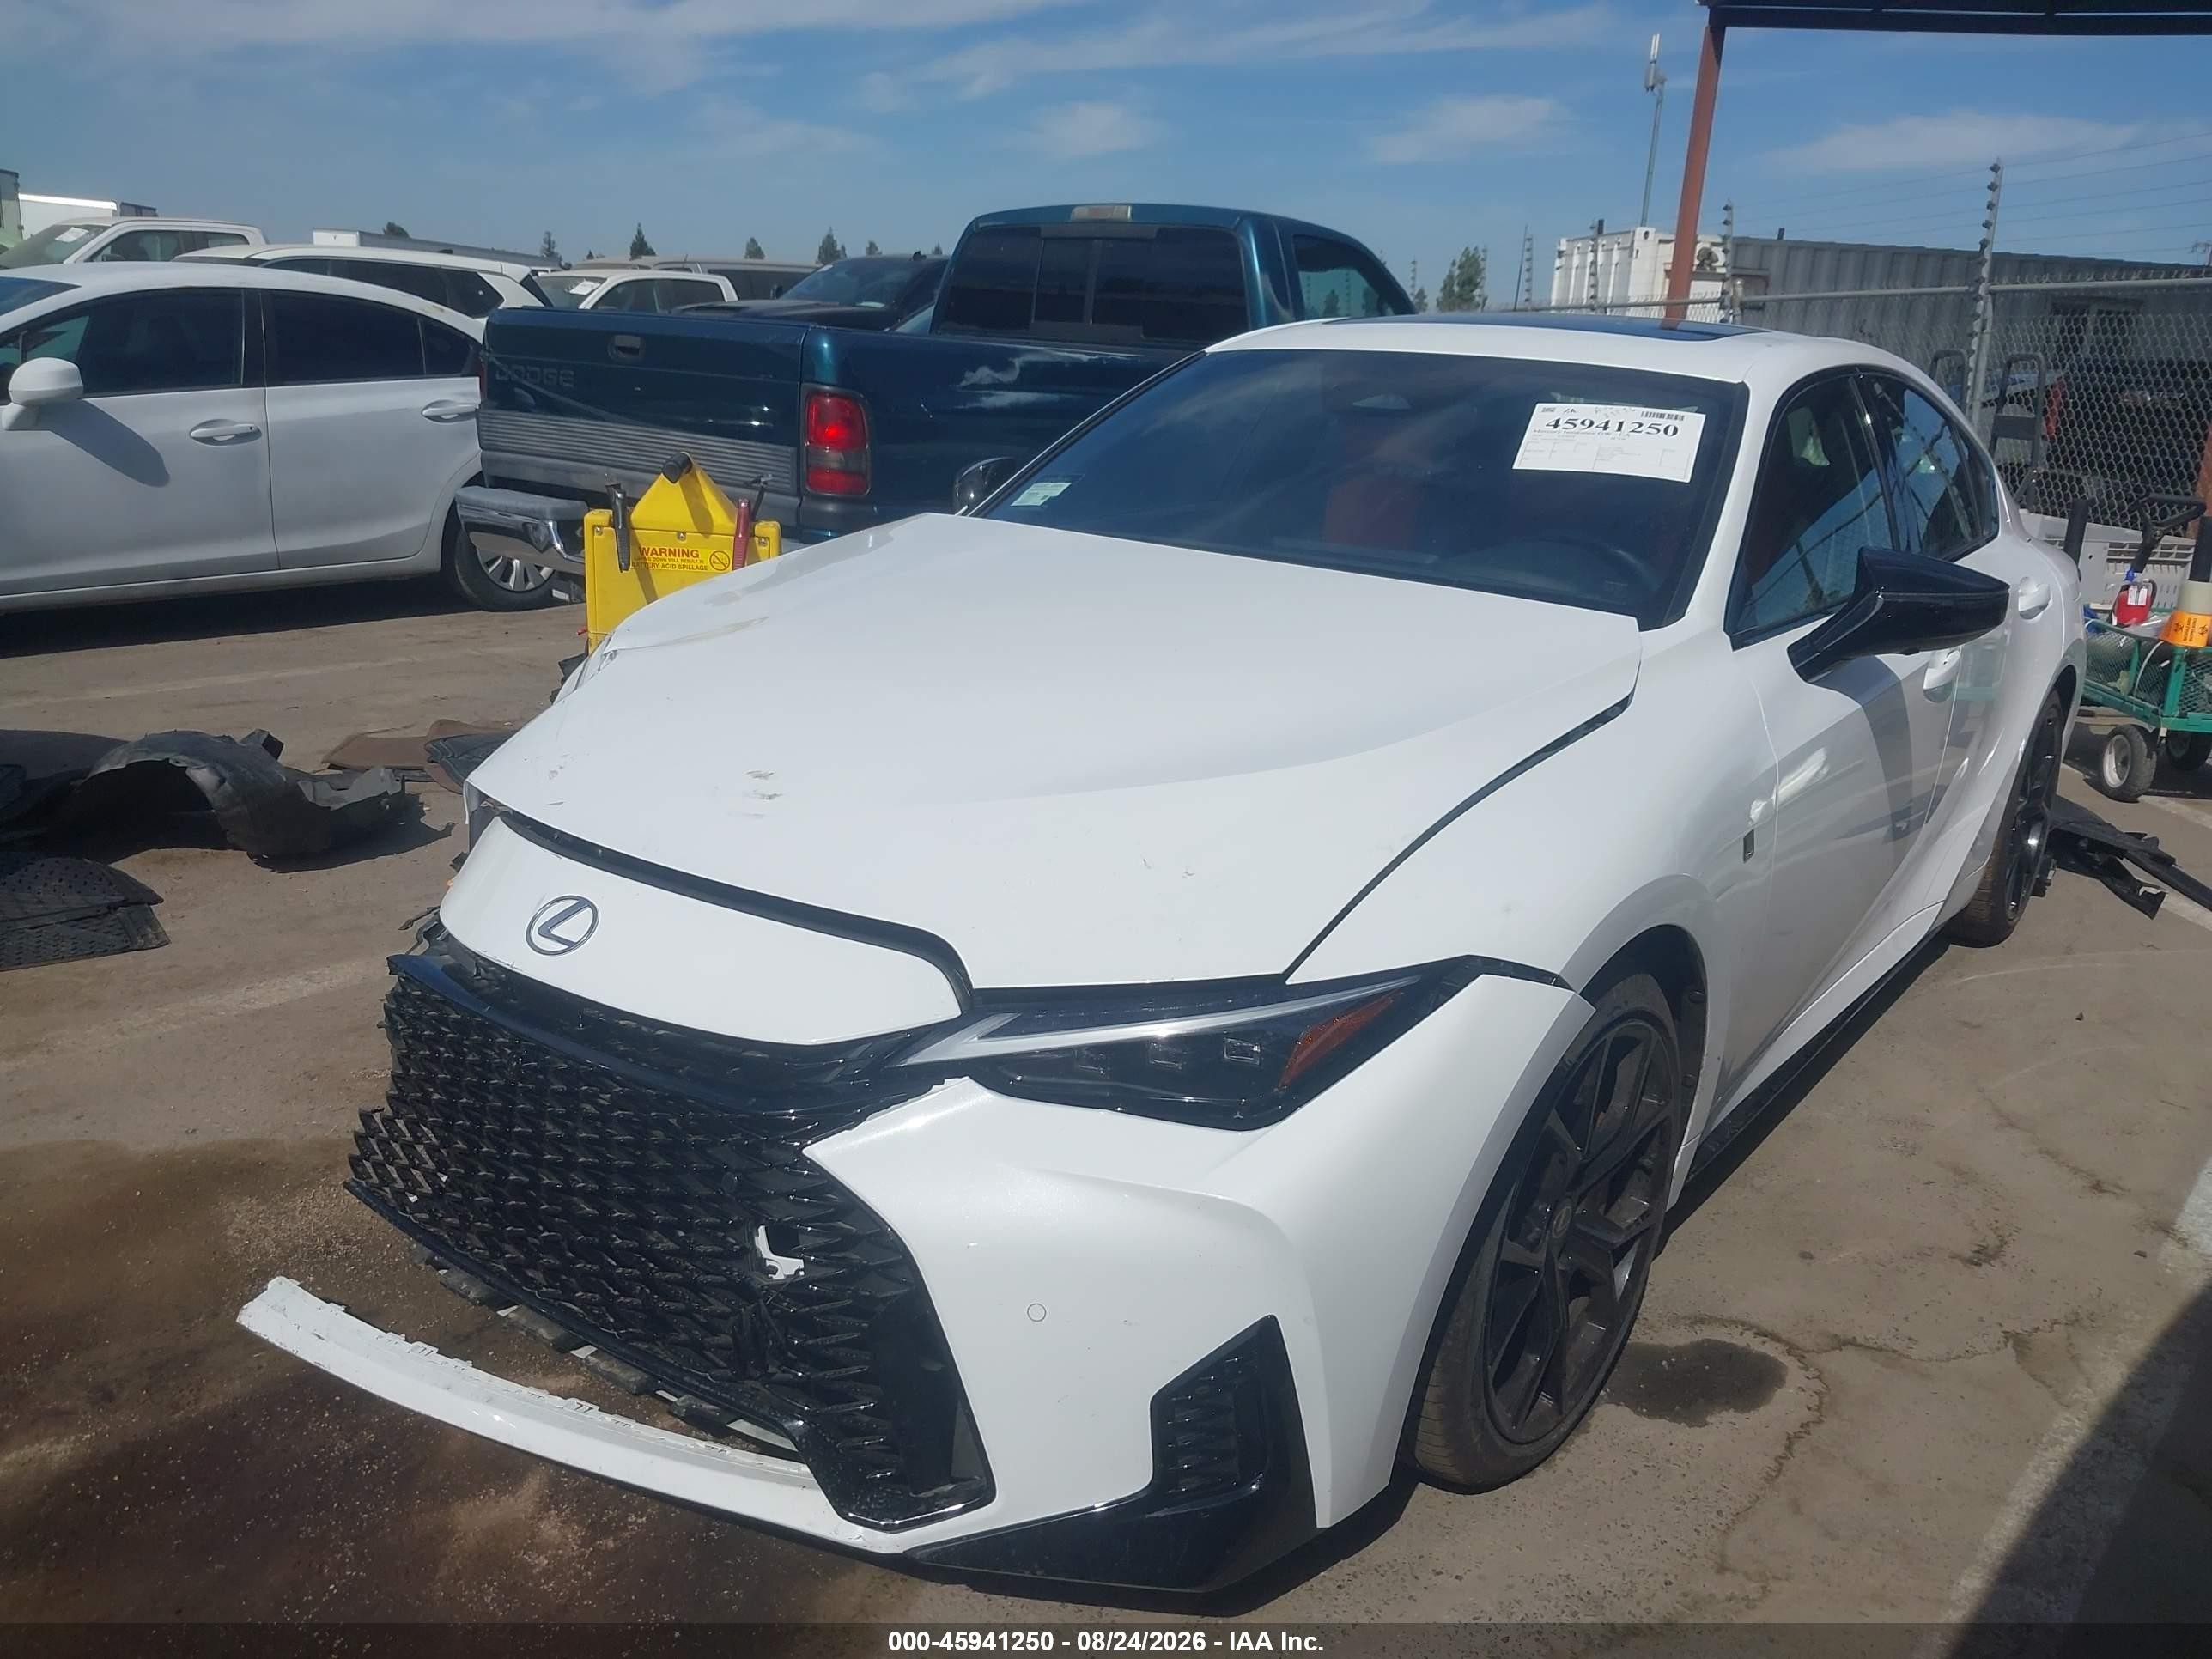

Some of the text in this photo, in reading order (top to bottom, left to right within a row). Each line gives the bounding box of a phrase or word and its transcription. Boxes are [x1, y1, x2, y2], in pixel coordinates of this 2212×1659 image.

[495, 364, 575, 387] DODGE
[1546, 417, 1679, 437] 45941250
[639, 546, 700, 558] WARNING
